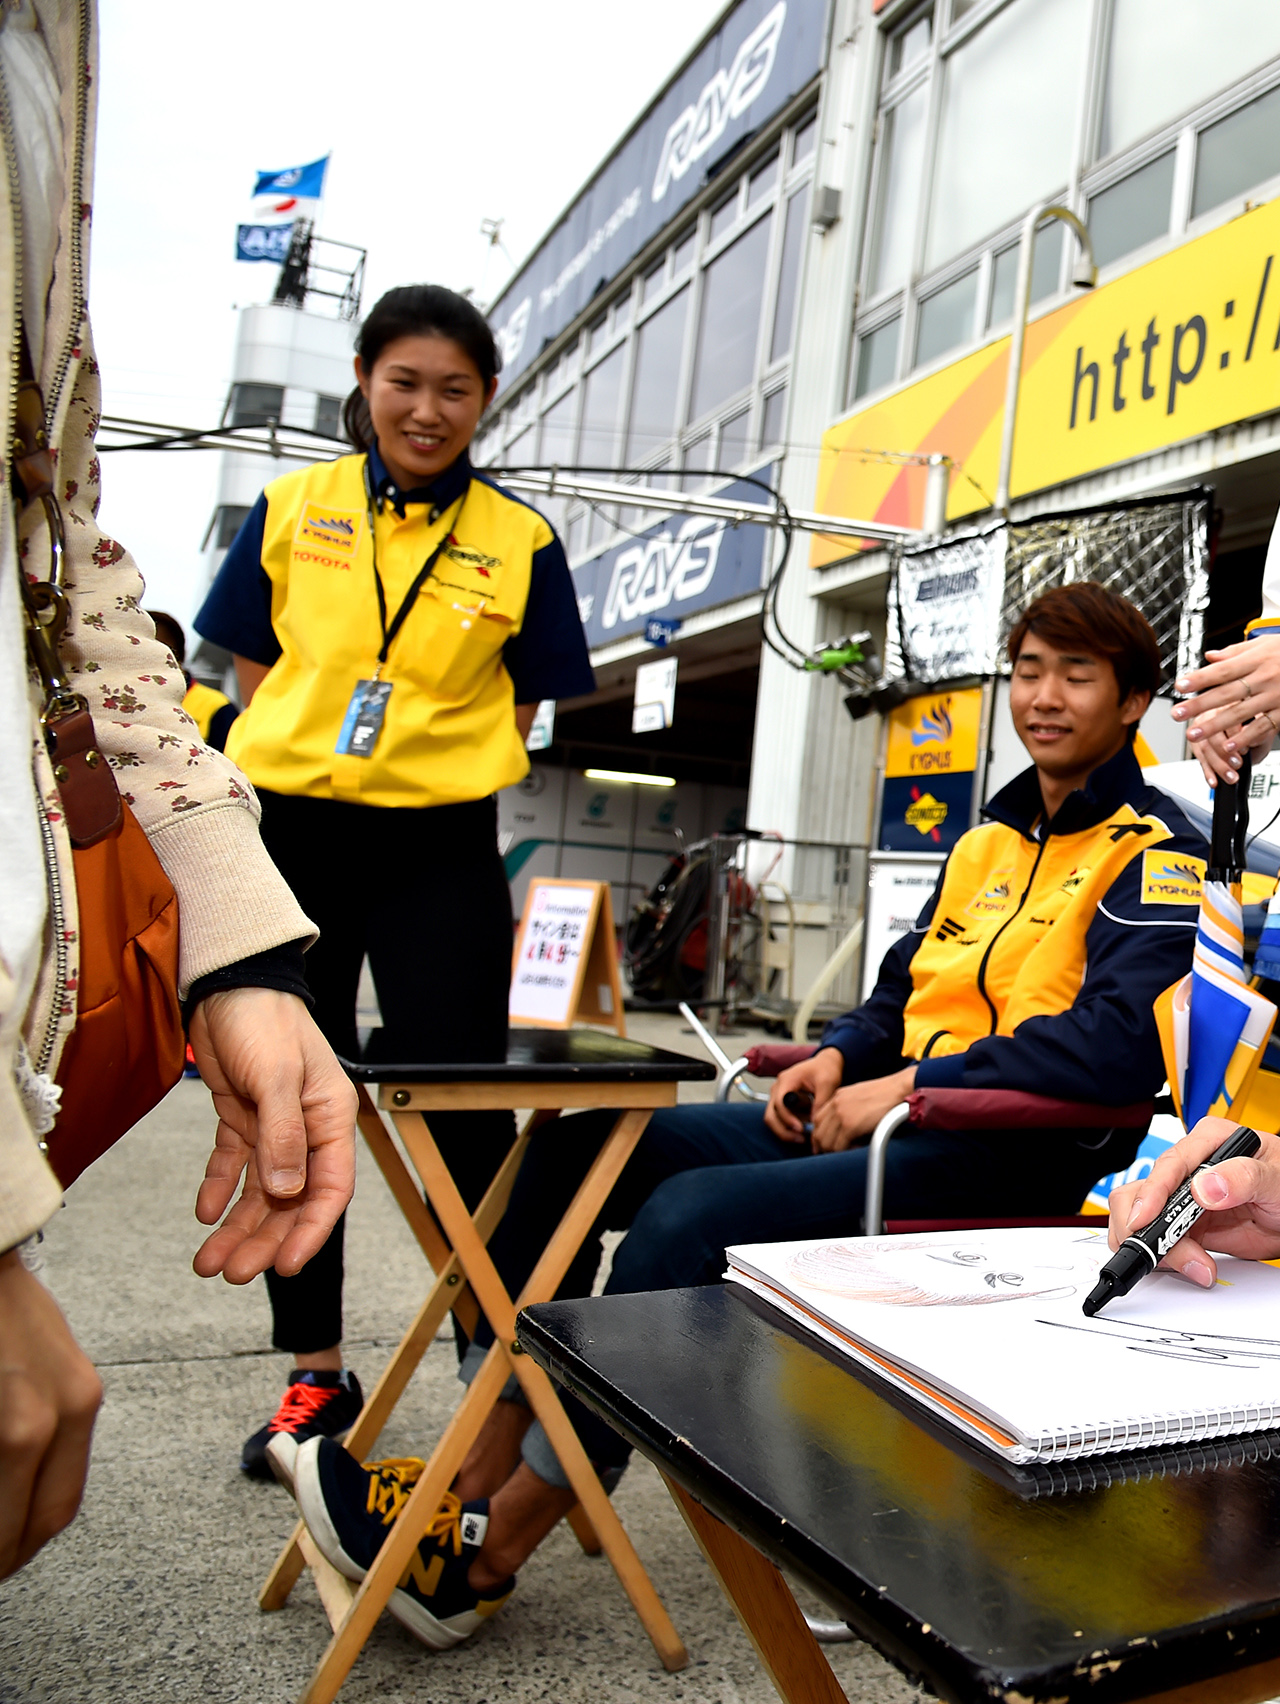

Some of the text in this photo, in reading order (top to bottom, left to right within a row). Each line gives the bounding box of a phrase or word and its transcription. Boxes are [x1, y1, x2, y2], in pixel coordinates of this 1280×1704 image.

[652, 1, 787, 203] RAYS
[293, 551, 351, 571] TOYOTA
[602, 515, 727, 630] RAYS
